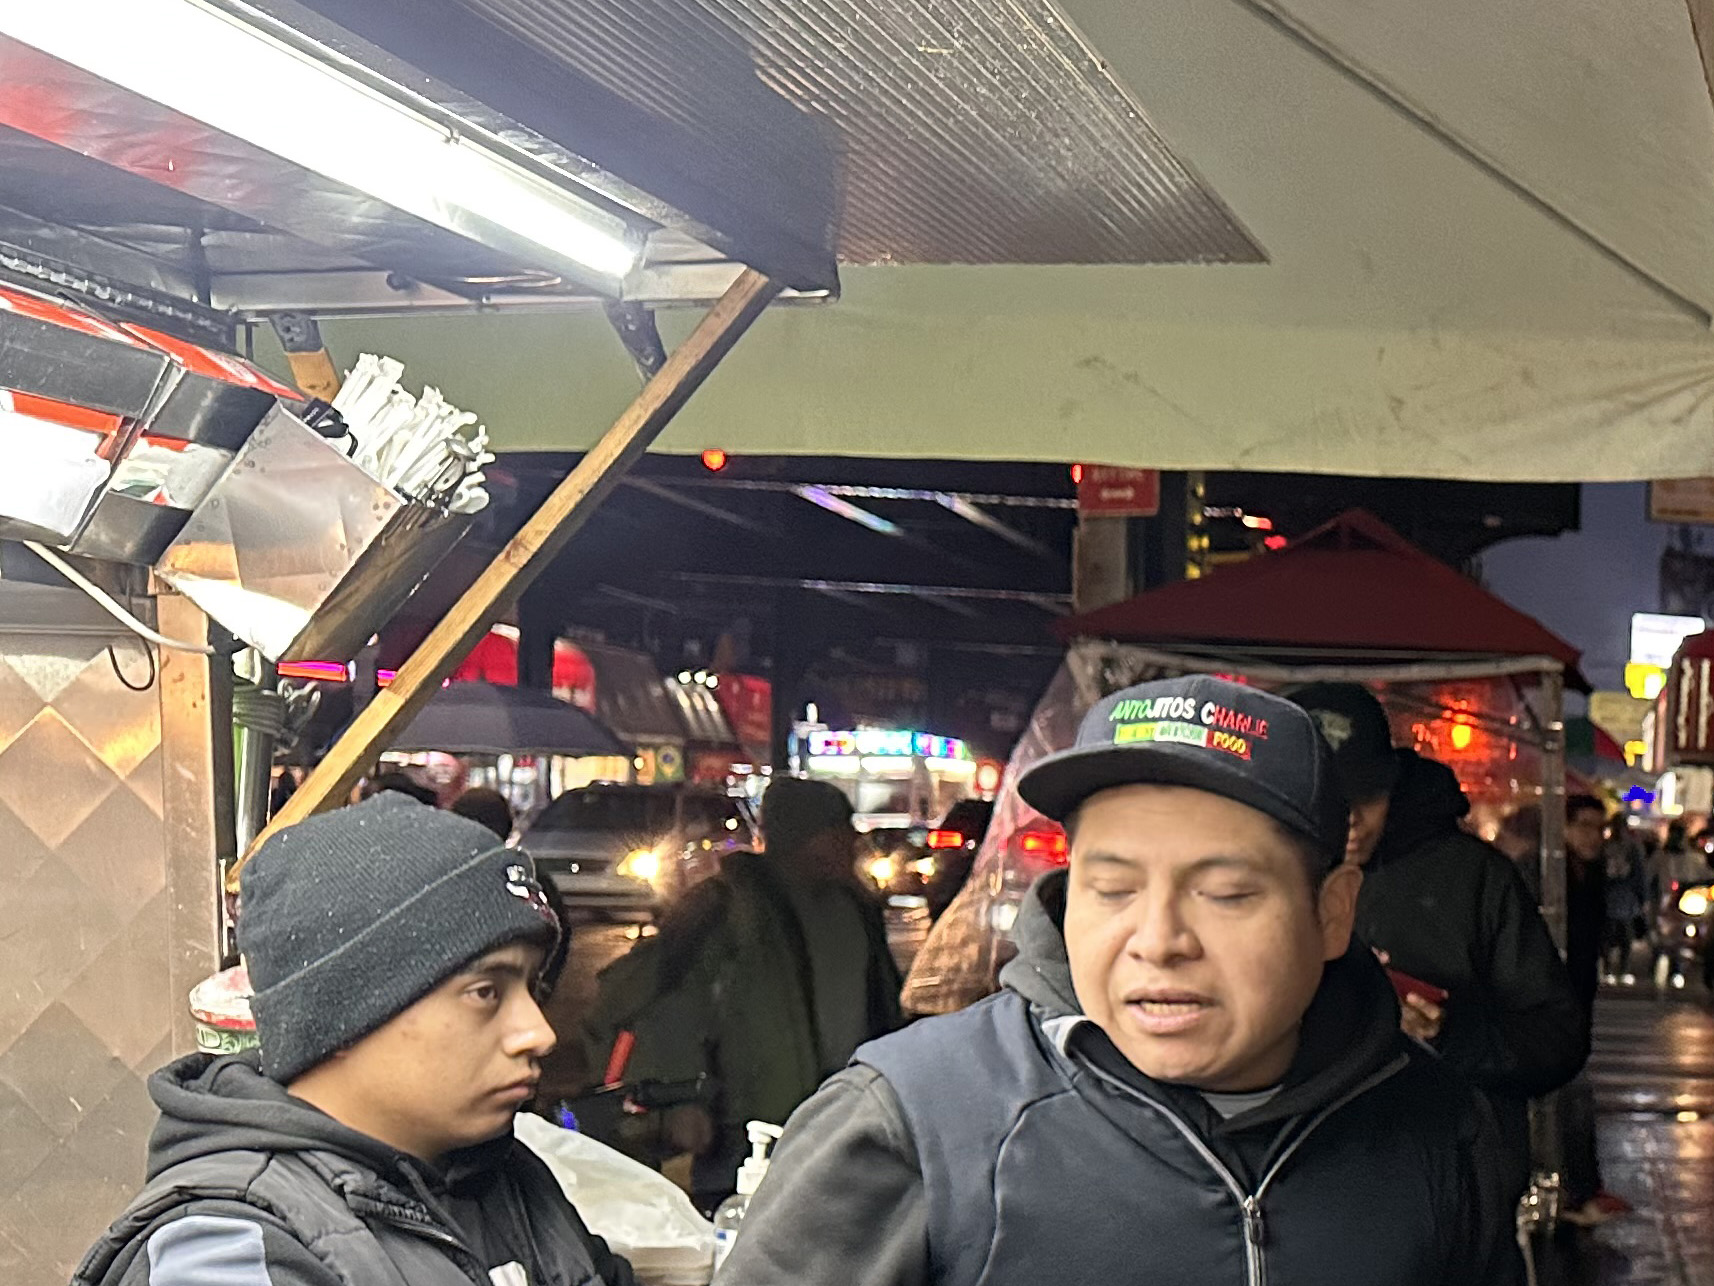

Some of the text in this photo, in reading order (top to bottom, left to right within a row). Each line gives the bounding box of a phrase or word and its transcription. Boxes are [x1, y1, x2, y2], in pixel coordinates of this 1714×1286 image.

[1109, 697, 1195, 721] ANTOJITOS
[1201, 702, 1268, 739] CHARLIE
[1213, 731, 1247, 754] FOOD
